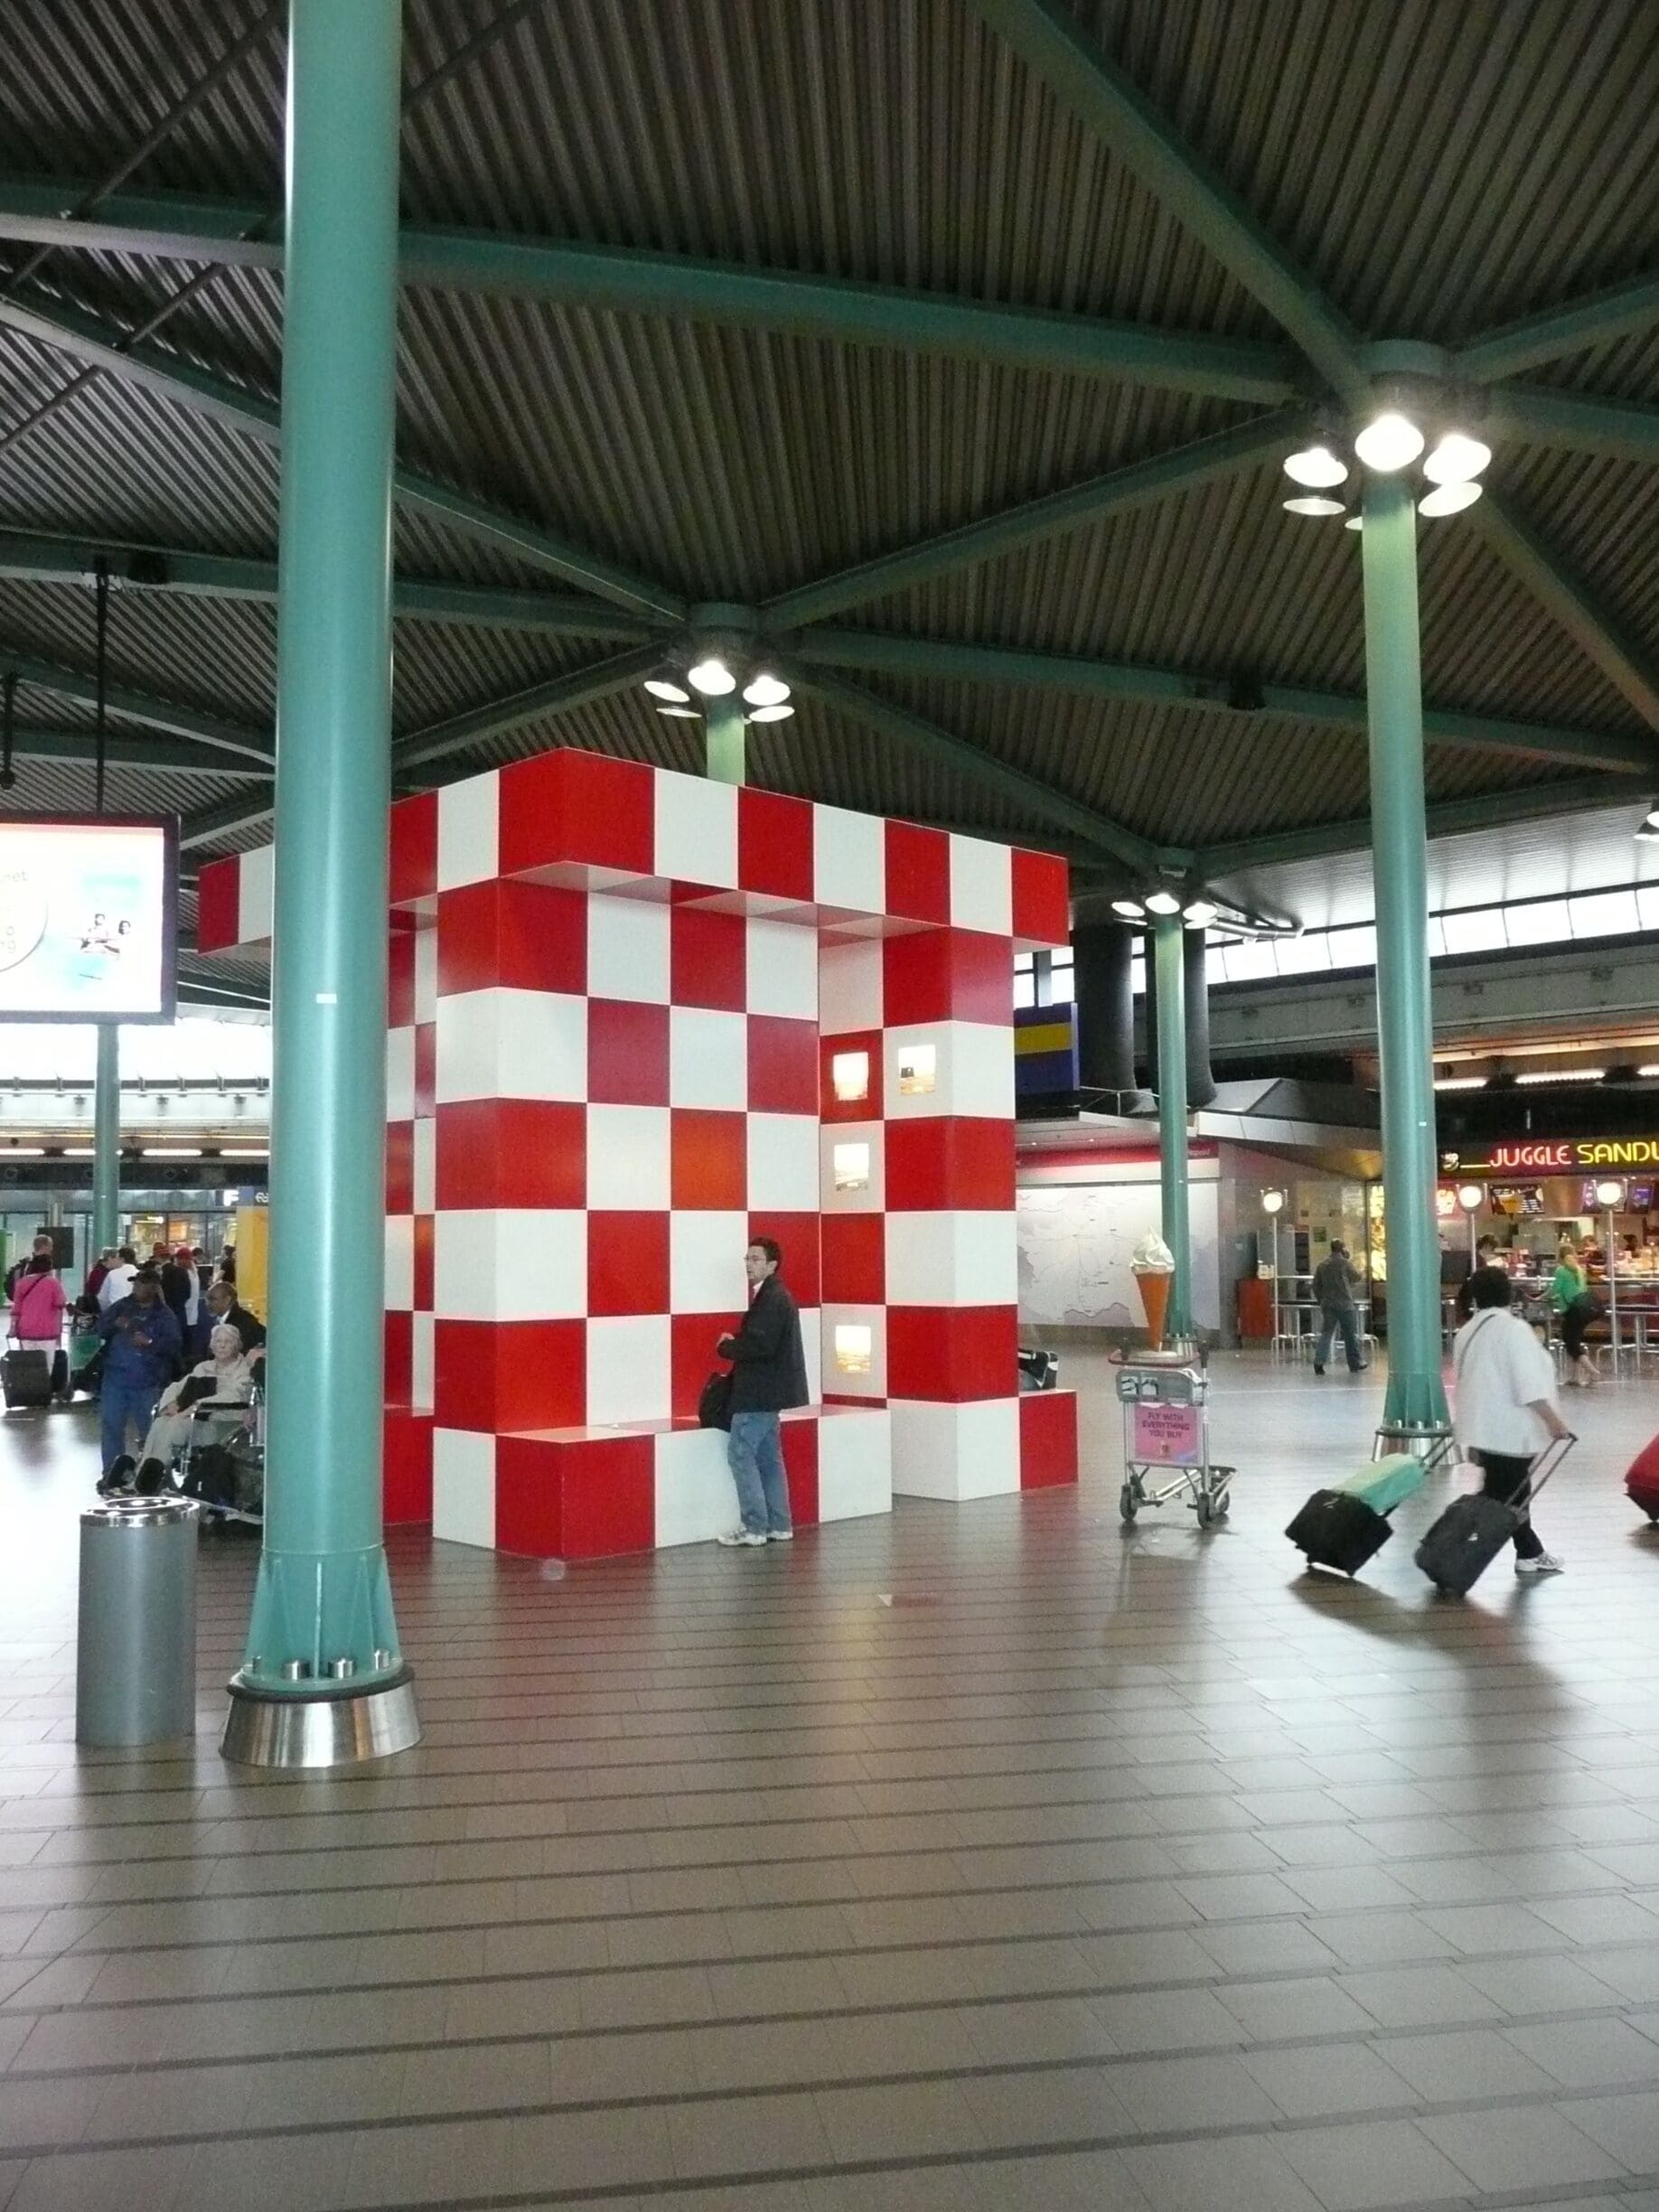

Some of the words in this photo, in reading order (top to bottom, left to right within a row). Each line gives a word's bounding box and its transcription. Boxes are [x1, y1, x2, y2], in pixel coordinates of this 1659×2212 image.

[1489, 1144, 1572, 1167] JUGGLE
[1148, 1411, 1160, 1420] FLY
[1142, 1420, 1190, 1430] EVERYTHING
[1167, 1430, 1182, 1439] BUY
